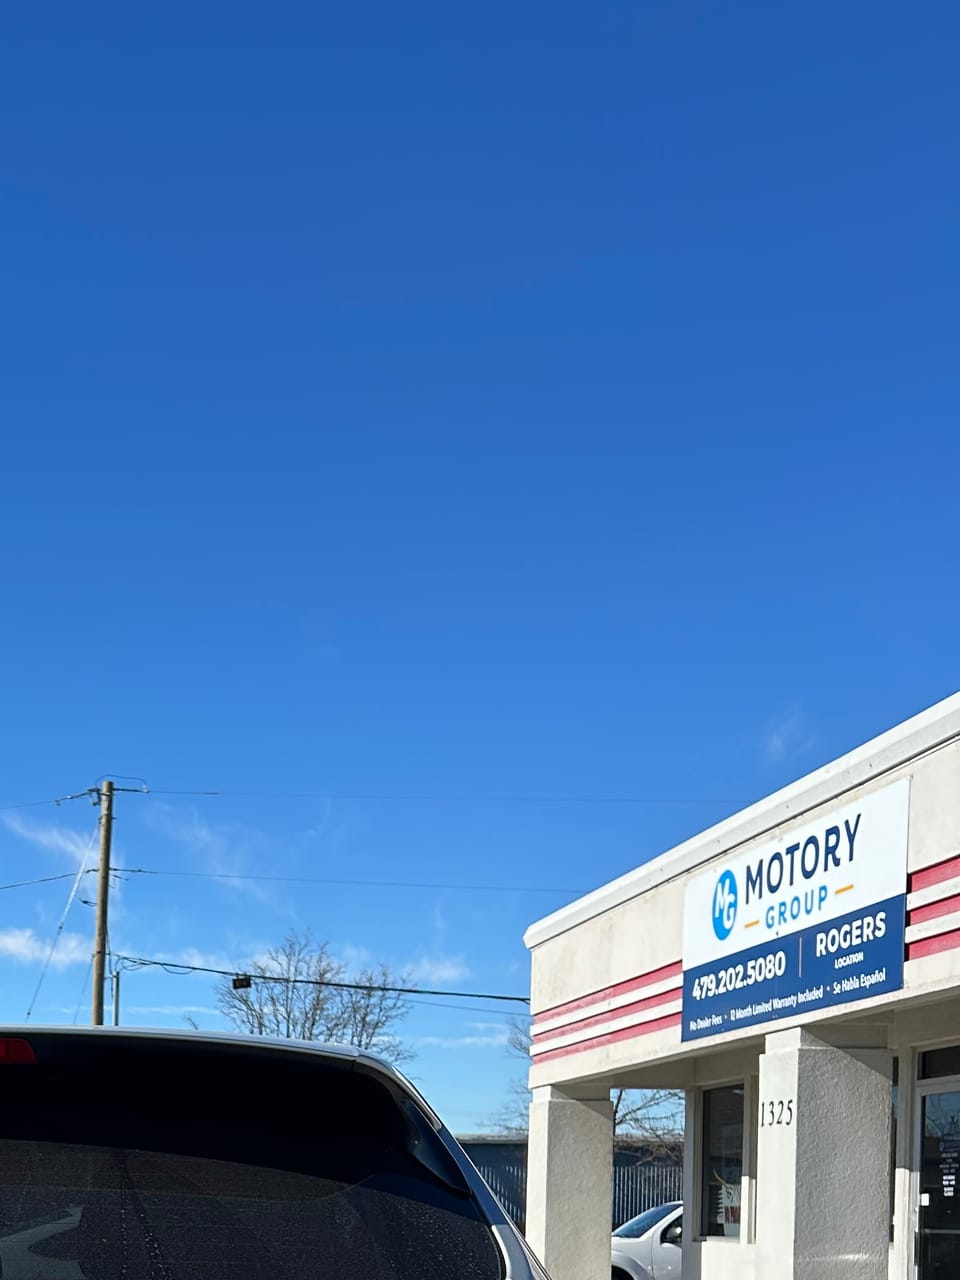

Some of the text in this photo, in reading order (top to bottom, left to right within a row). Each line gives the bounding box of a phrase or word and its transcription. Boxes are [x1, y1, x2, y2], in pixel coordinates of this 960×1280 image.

[745, 813, 861, 904] MOTORY
[765, 885, 828, 929] GROUP
[815, 911, 886, 957] ROGERS
[692, 950, 786, 1000] 479.202.5080
[834, 951, 864, 969] LOCATION
[735, 1004, 752, 1019] Month
[752, 998, 772, 1015] Limited
[772, 995, 797, 1010] Warranty
[797, 984, 824, 1003] Included
[833, 981, 841, 994] Se
[841, 975, 860, 992] Habla
[860, 967, 886, 988] Español
[761, 1099, 793, 1127] 1325
